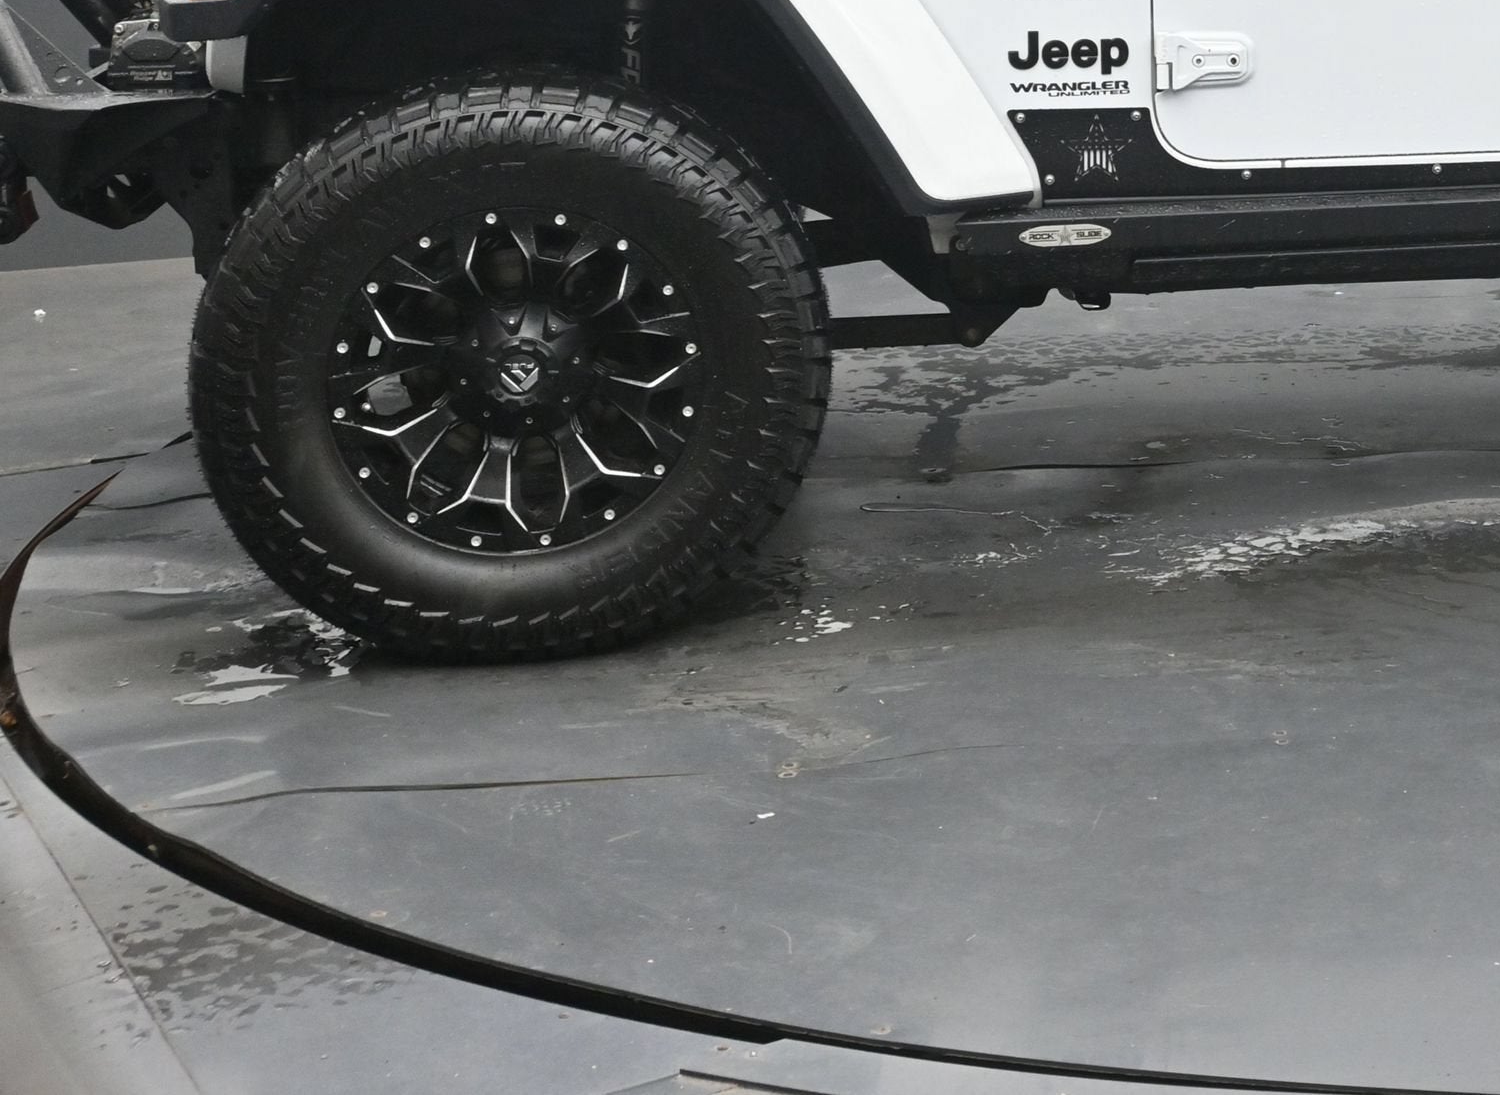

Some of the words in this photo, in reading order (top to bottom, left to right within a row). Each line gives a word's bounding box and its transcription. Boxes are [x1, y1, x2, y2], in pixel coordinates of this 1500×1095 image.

[1008, 30, 1130, 75] Jeep
[1010, 80, 1130, 93] WRANGLER
[1048, 89, 1130, 97] UNLIMITED
